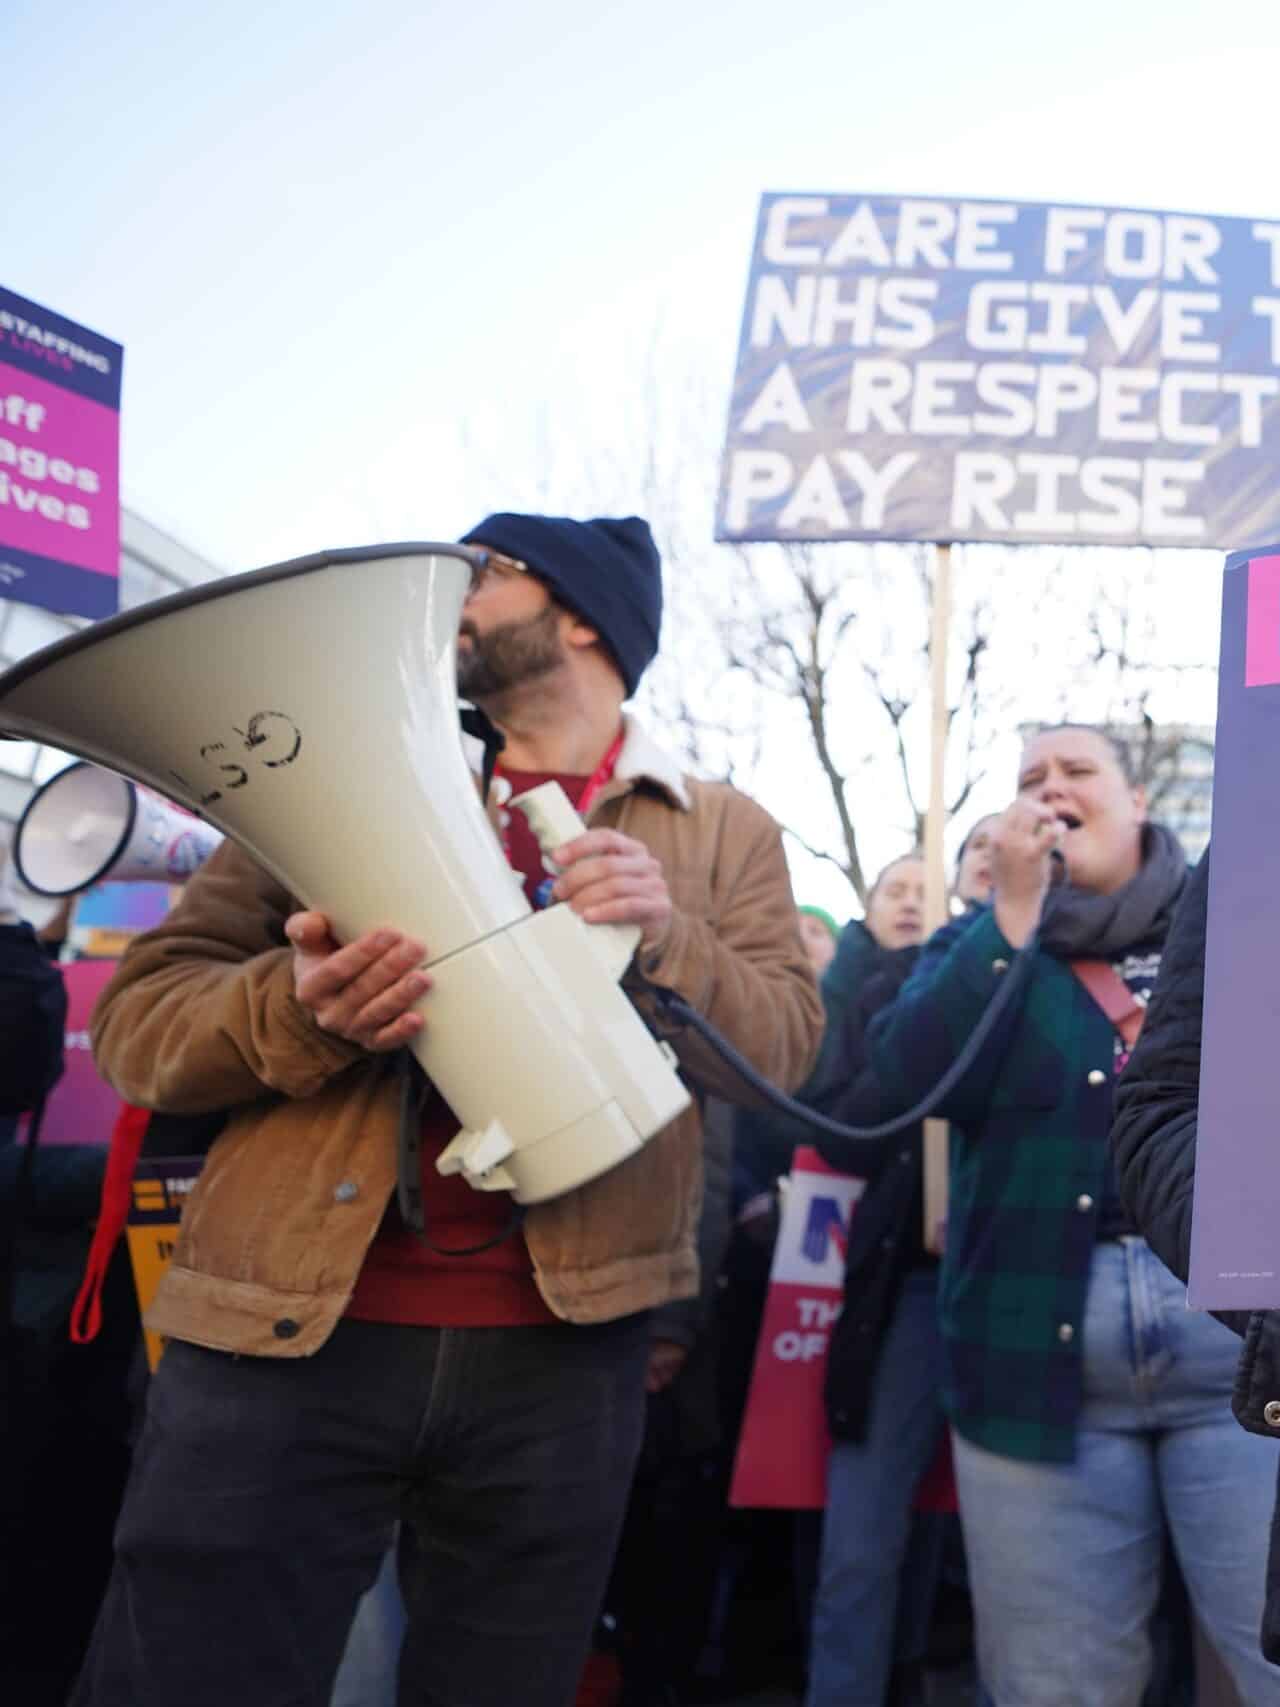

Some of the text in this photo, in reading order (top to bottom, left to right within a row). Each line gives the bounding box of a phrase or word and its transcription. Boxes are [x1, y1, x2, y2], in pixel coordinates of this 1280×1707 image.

[763, 197, 1018, 273] CARE
[1043, 206, 1222, 284] FOR
[751, 275, 938, 349] NHS
[966, 280, 1222, 361] GIVE
[740, 368, 810, 433] A
[723, 449, 1206, 538] PAY RISE
